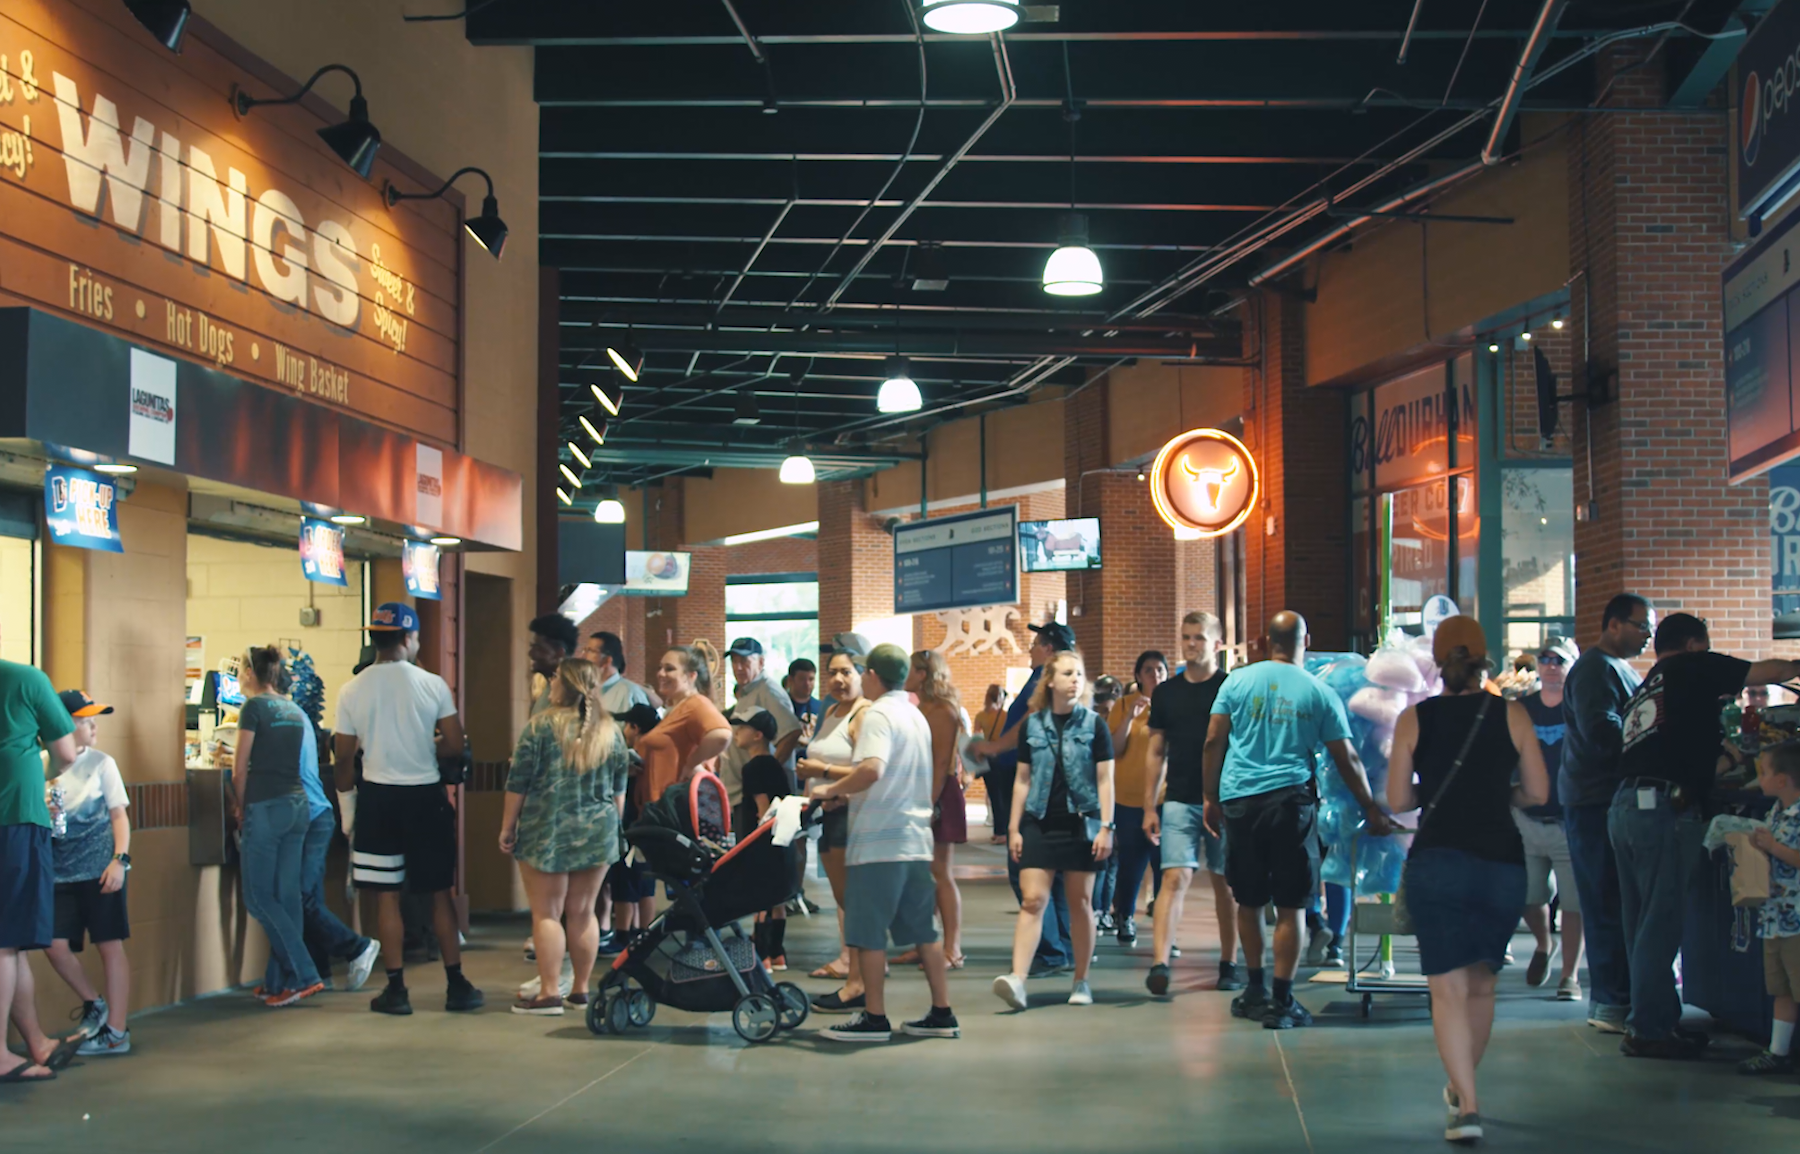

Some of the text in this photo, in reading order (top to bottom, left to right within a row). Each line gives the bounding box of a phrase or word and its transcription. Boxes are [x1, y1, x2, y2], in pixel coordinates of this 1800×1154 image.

[20, 50, 38, 100] &
[52, 70, 359, 326] WINGS
[369, 243, 415, 315] Sweet &
[69, 262, 349, 405] Fries Hot Dogs Wing Basket
[373, 291, 408, 355] Spicy!
[69, 477, 113, 509] PICK-UP
[75, 504, 112, 539] HERE
